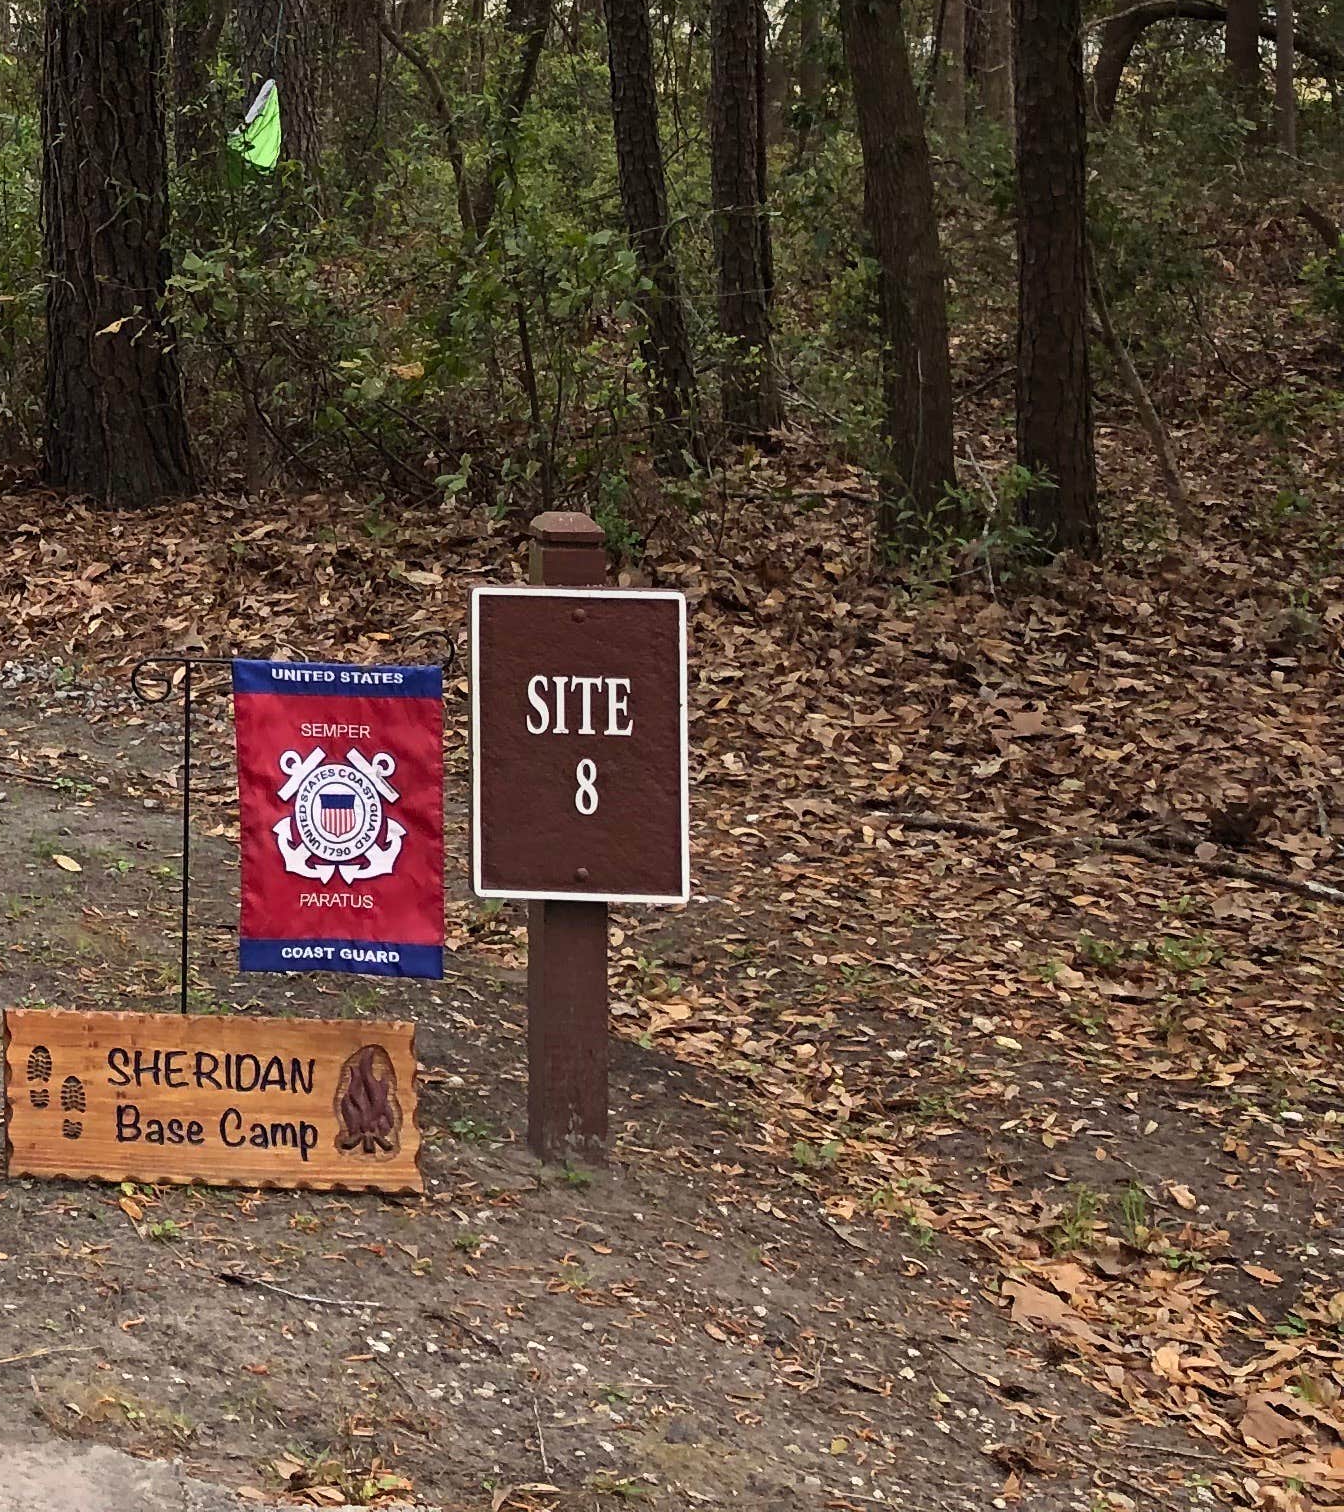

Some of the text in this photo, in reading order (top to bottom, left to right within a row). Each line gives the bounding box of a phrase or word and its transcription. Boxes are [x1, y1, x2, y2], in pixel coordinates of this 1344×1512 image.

[271, 668, 404, 685] UNITED STATES
[526, 675, 634, 737] SITE
[300, 722, 372, 739] SEMPER
[574, 758, 599, 816] 8
[298, 768, 379, 851] UNITED STATES COAST GUARD
[322, 846, 351, 857] 1790
[299, 892, 375, 909] PARATUS
[281, 946, 401, 963] COAST GUARD
[107, 1046, 316, 1095] SHERIDAN
[115, 1104, 319, 1162] Base Camp
